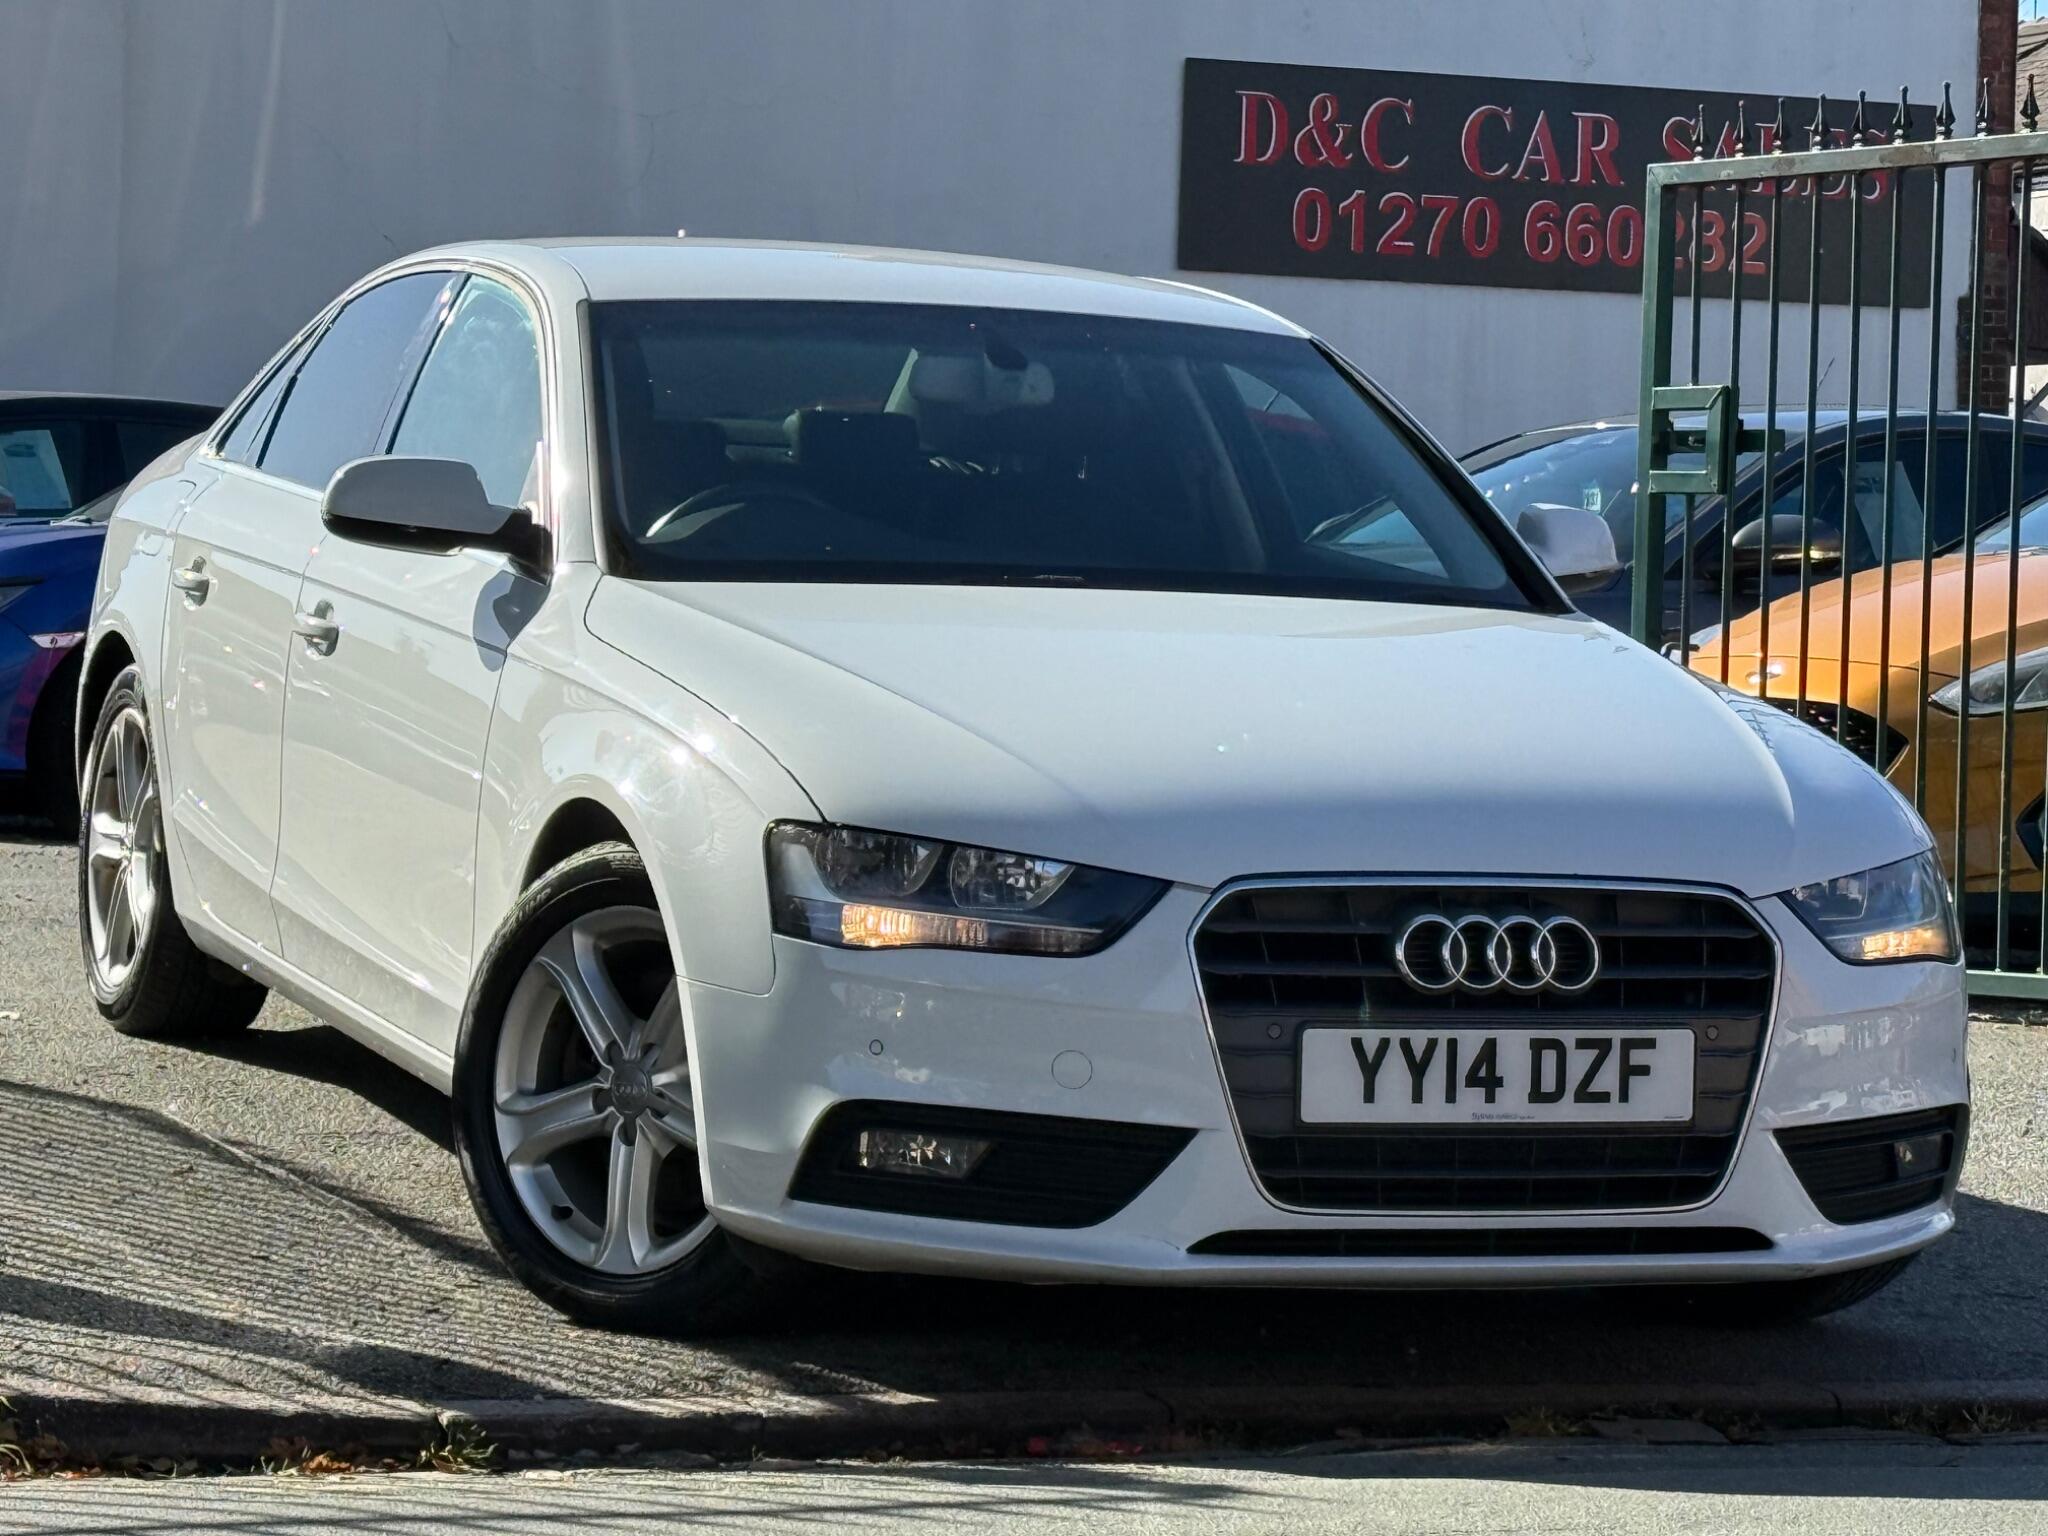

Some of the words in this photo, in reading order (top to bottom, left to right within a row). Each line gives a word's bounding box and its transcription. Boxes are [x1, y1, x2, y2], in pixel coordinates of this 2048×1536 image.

[1233, 90, 1415, 173] D&C
[1461, 104, 1625, 187] CAR
[1293, 187, 1500, 258] 01270
[1350, 1037, 1504, 1105] YY14
[1527, 1037, 1657, 1105] DZF
